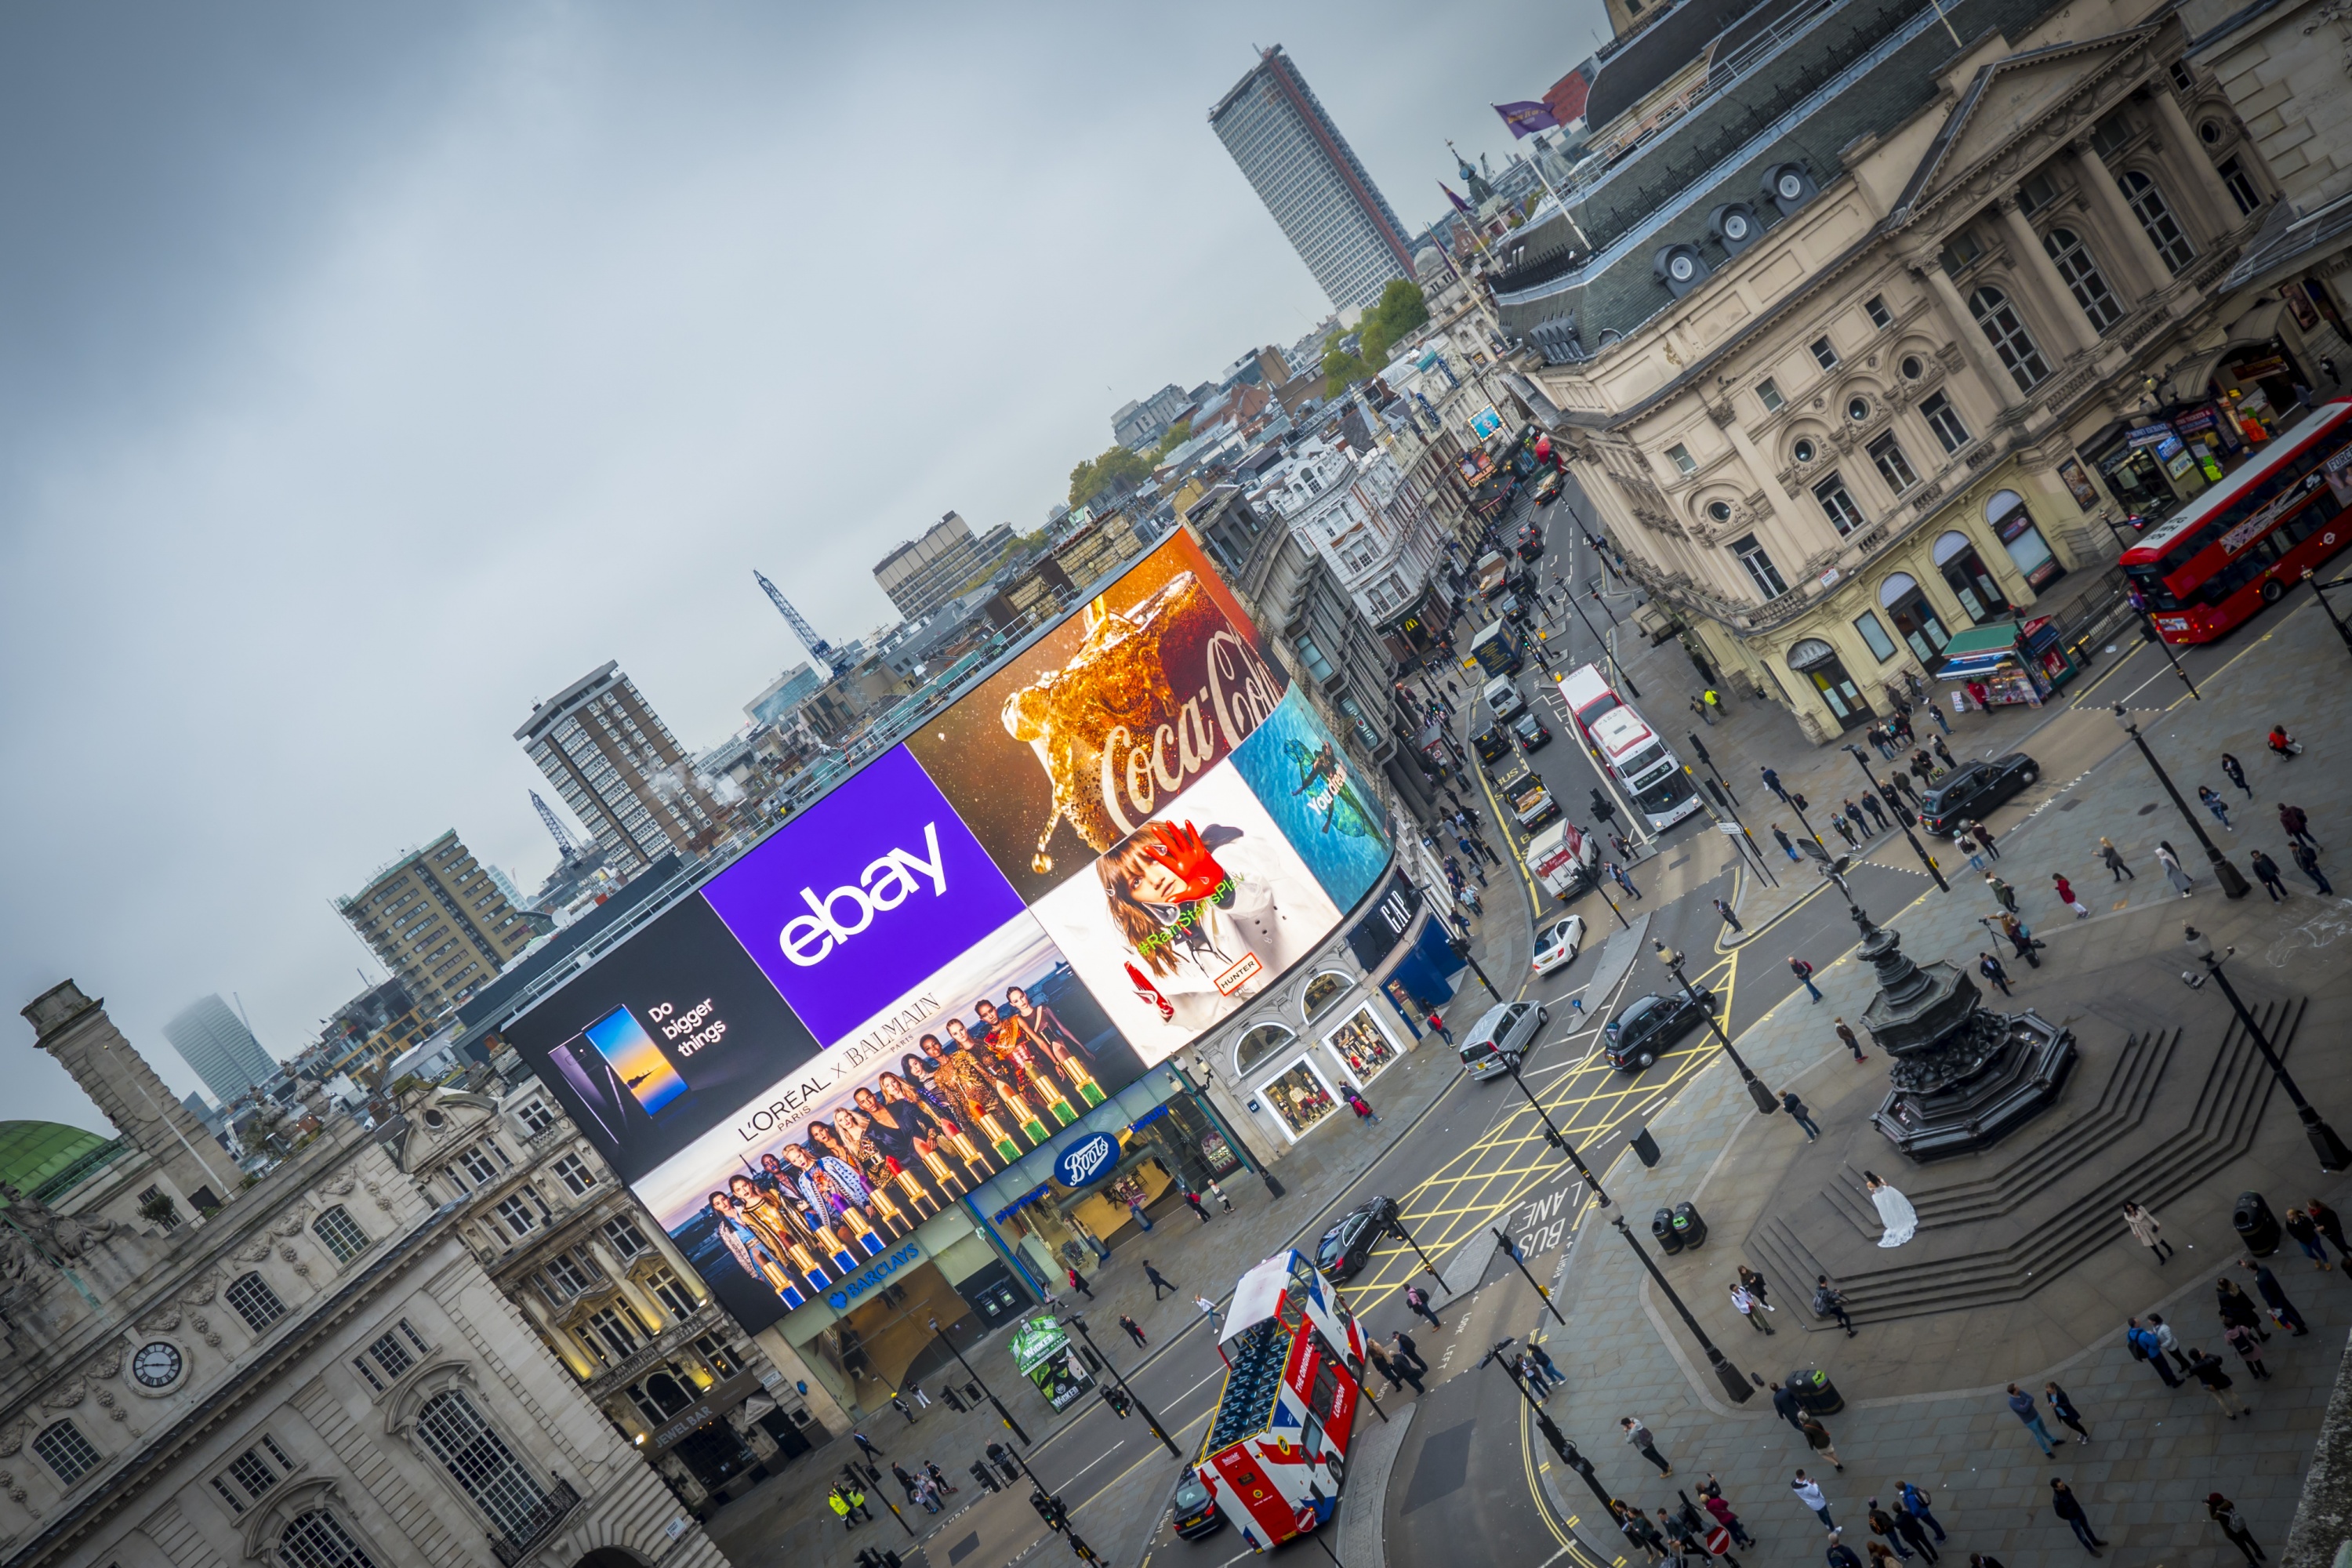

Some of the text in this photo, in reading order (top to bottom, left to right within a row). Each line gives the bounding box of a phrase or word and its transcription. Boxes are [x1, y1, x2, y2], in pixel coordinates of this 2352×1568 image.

[1440, 363, 1459, 388] APOLLO
[1420, 398, 1439, 423] LYRIC
[1471, 464, 1495, 482] THRILLER
[2328, 448, 2352, 470] FORC
[1307, 789, 1333, 816] You
[779, 821, 947, 967] ebay
[1381, 891, 1411, 933] GAP
[1221, 960, 1256, 989] HUNTER
[648, 1001, 673, 1023] Do
[661, 996, 715, 1041] bigger
[677, 1018, 728, 1058] things
[842, 991, 942, 1069] BALMAIN
[890, 1034, 915, 1053] PARIS
[1127, 1104, 1170, 1134] beauty
[1064, 1135, 1109, 1186] Boots
[994, 1184, 1049, 1225] pharmacy
[1515, 1181, 1583, 1234] LANE
[1519, 1218, 1566, 1258] BUS
[846, 1243, 920, 1298] BARCLAYS
[1553, 1254, 1569, 1279] RIGHT
[1455, 1312, 1472, 1335] LOOK
[1299, 1344, 1314, 1379] ORIGINAL
[1437, 1344, 1456, 1370] LEFT
[1295, 1372, 1305, 1393] THE
[1333, 1383, 1346, 1418] LONDON
[655, 1422, 689, 1448] JEWEL
[686, 1406, 713, 1426] BAR
[942, 1504, 970, 1529] RIGHT
[1155, 1508, 1174, 1534] RIGHT
[1007, 1539, 1040, 1567] LEFT
